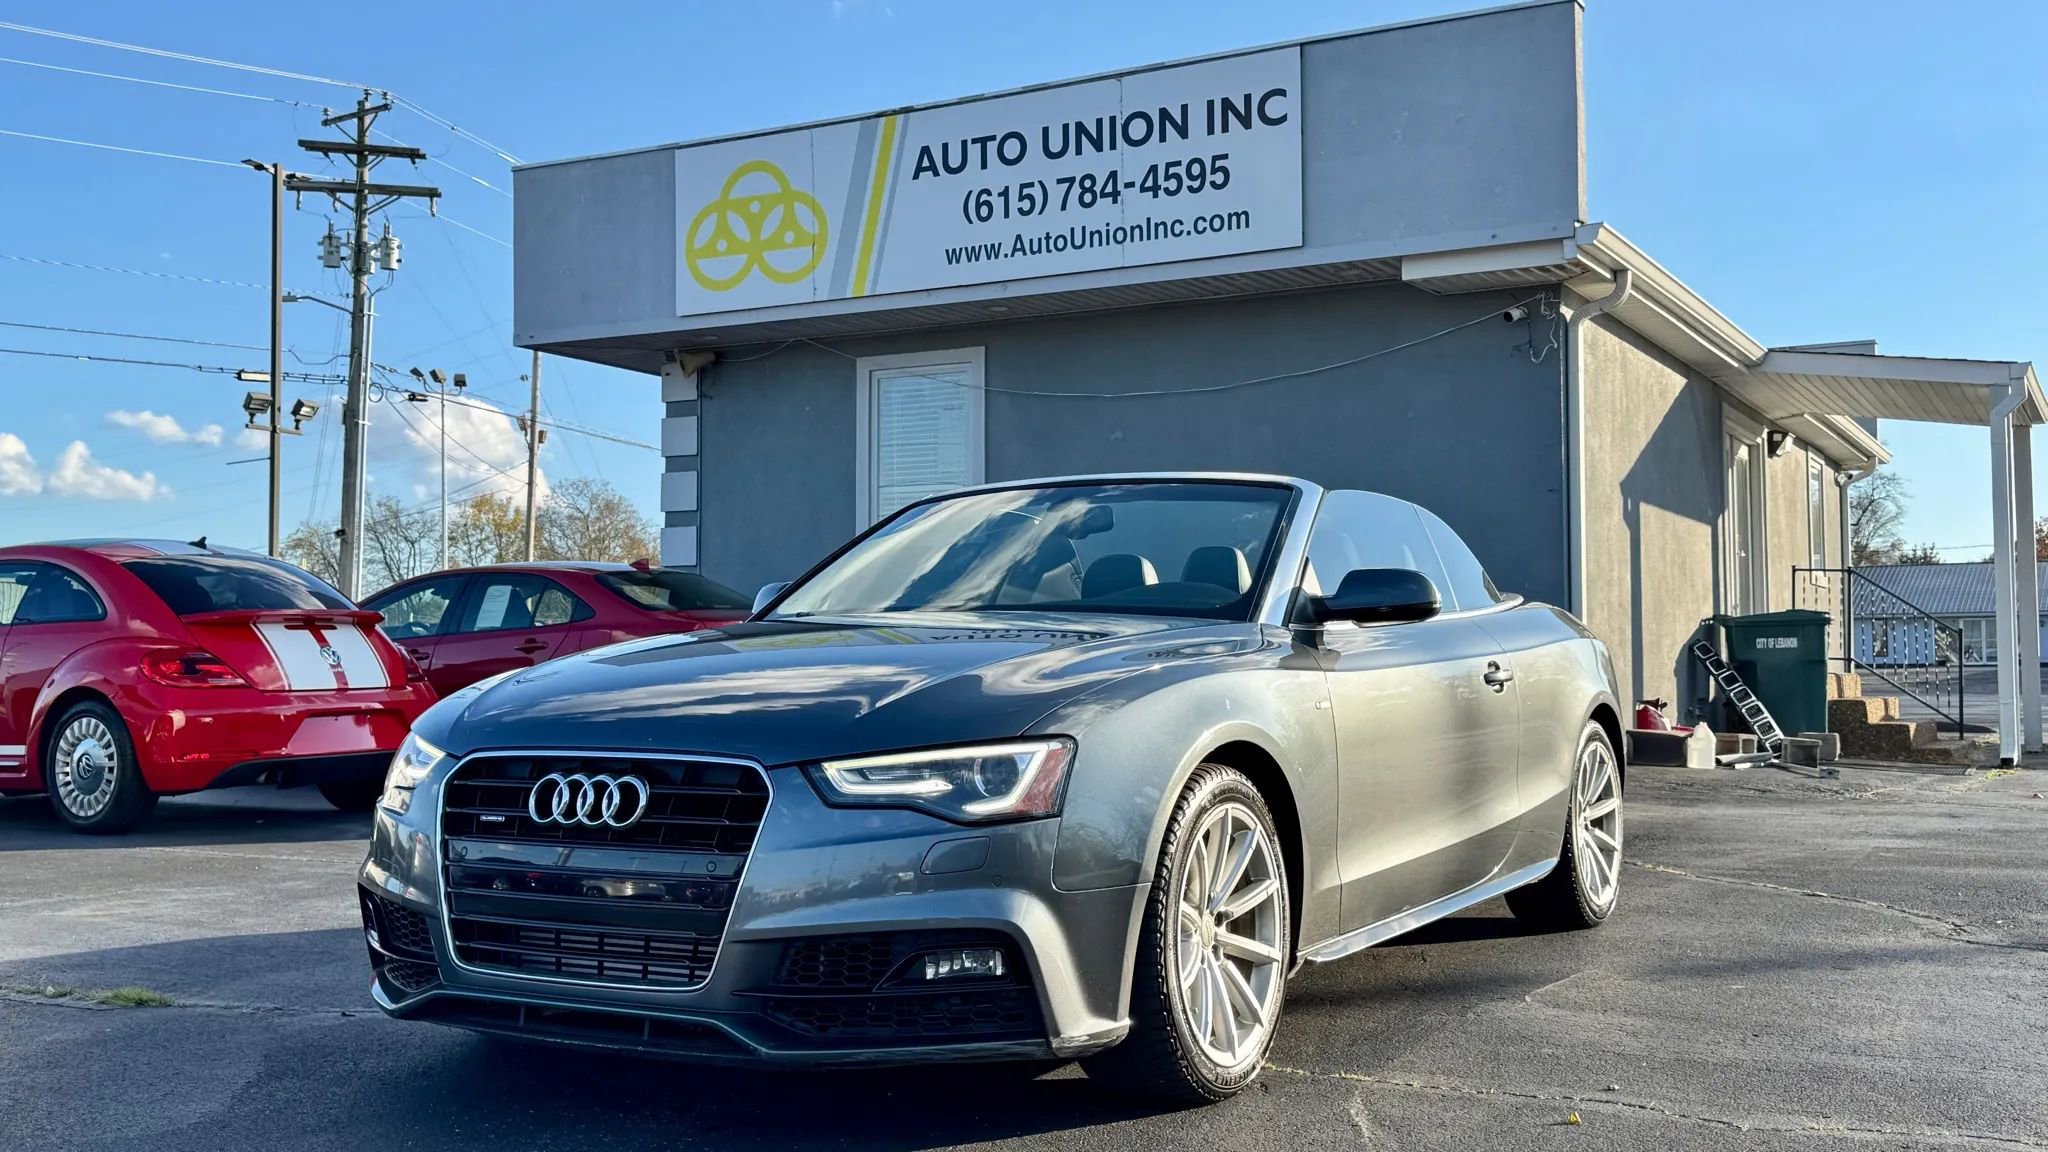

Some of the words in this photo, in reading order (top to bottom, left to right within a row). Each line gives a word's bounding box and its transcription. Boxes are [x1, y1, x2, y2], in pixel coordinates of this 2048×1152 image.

[912, 131, 1028, 180] AUTO
[1042, 103, 1189, 159] UNION
[1207, 88, 1288, 136] INC
[963, 181, 1049, 224] (615)
[1056, 153, 1231, 211] 784-4595
[945, 210, 1250, 265] www.AutoUnionInc.com
[1756, 637, 1767, 649] CITY
[1768, 637, 1775, 649] OF
